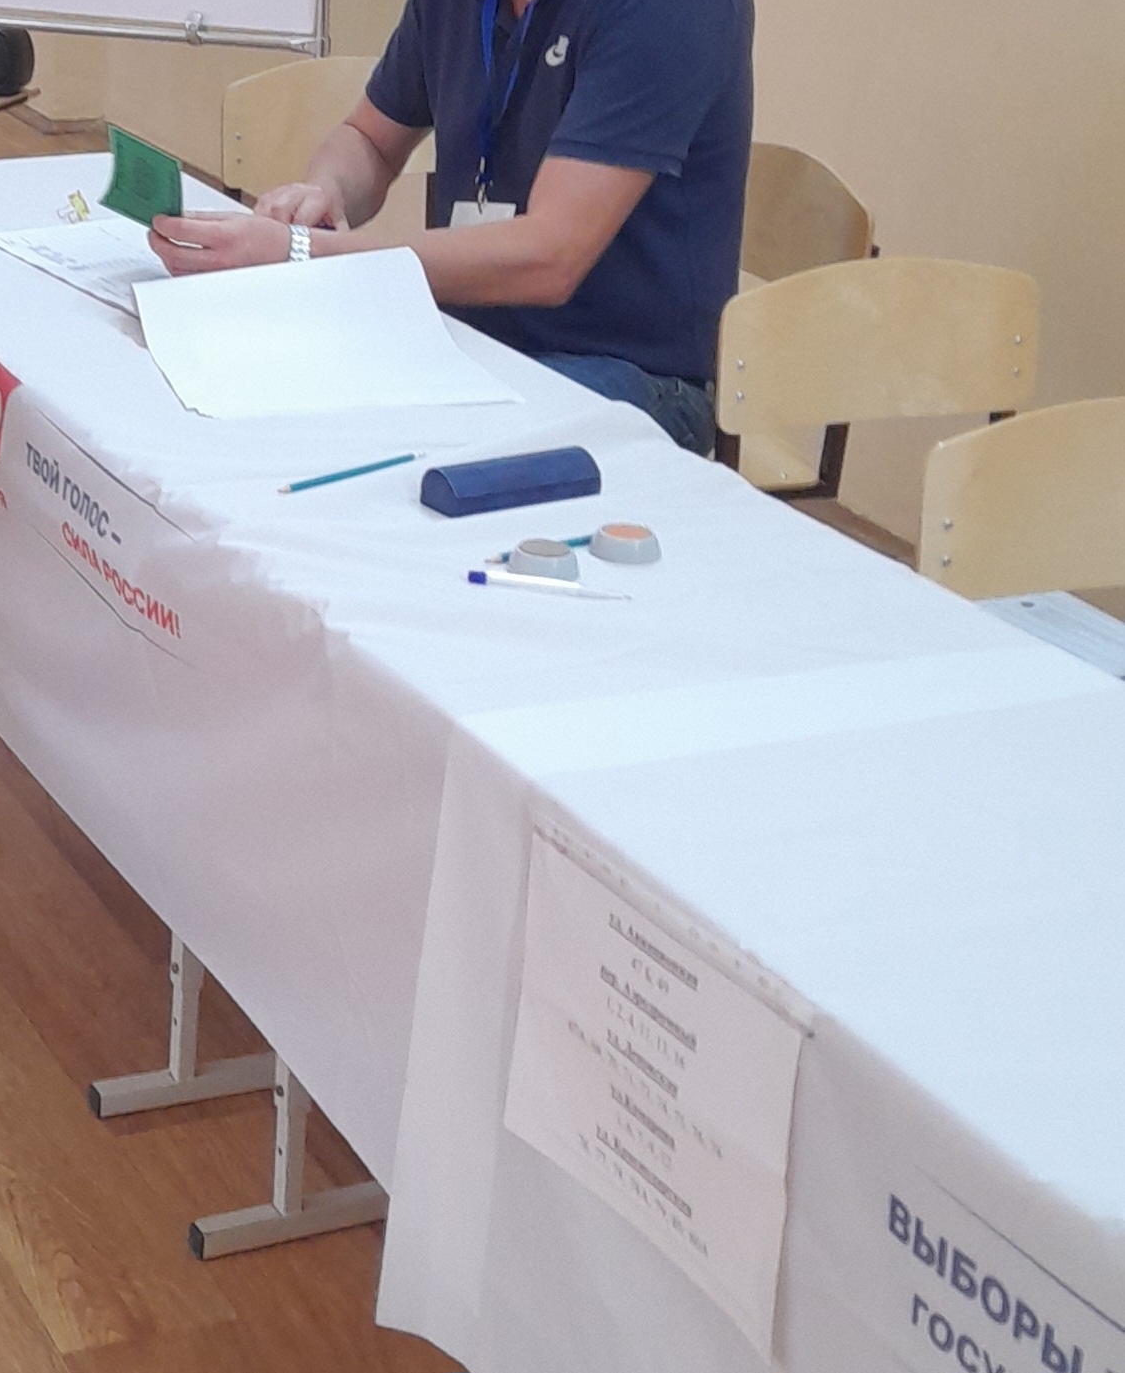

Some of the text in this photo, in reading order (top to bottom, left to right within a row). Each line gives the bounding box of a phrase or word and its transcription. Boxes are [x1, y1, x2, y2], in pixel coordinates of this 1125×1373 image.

[26, 441, 59, 494] ТВОЙ
[62, 475, 110, 537] ГОЛОС
[62, 521, 181, 640] СИЛА РОССИИ!
[888, 1192, 1085, 1373] ВЫБОРЫ
